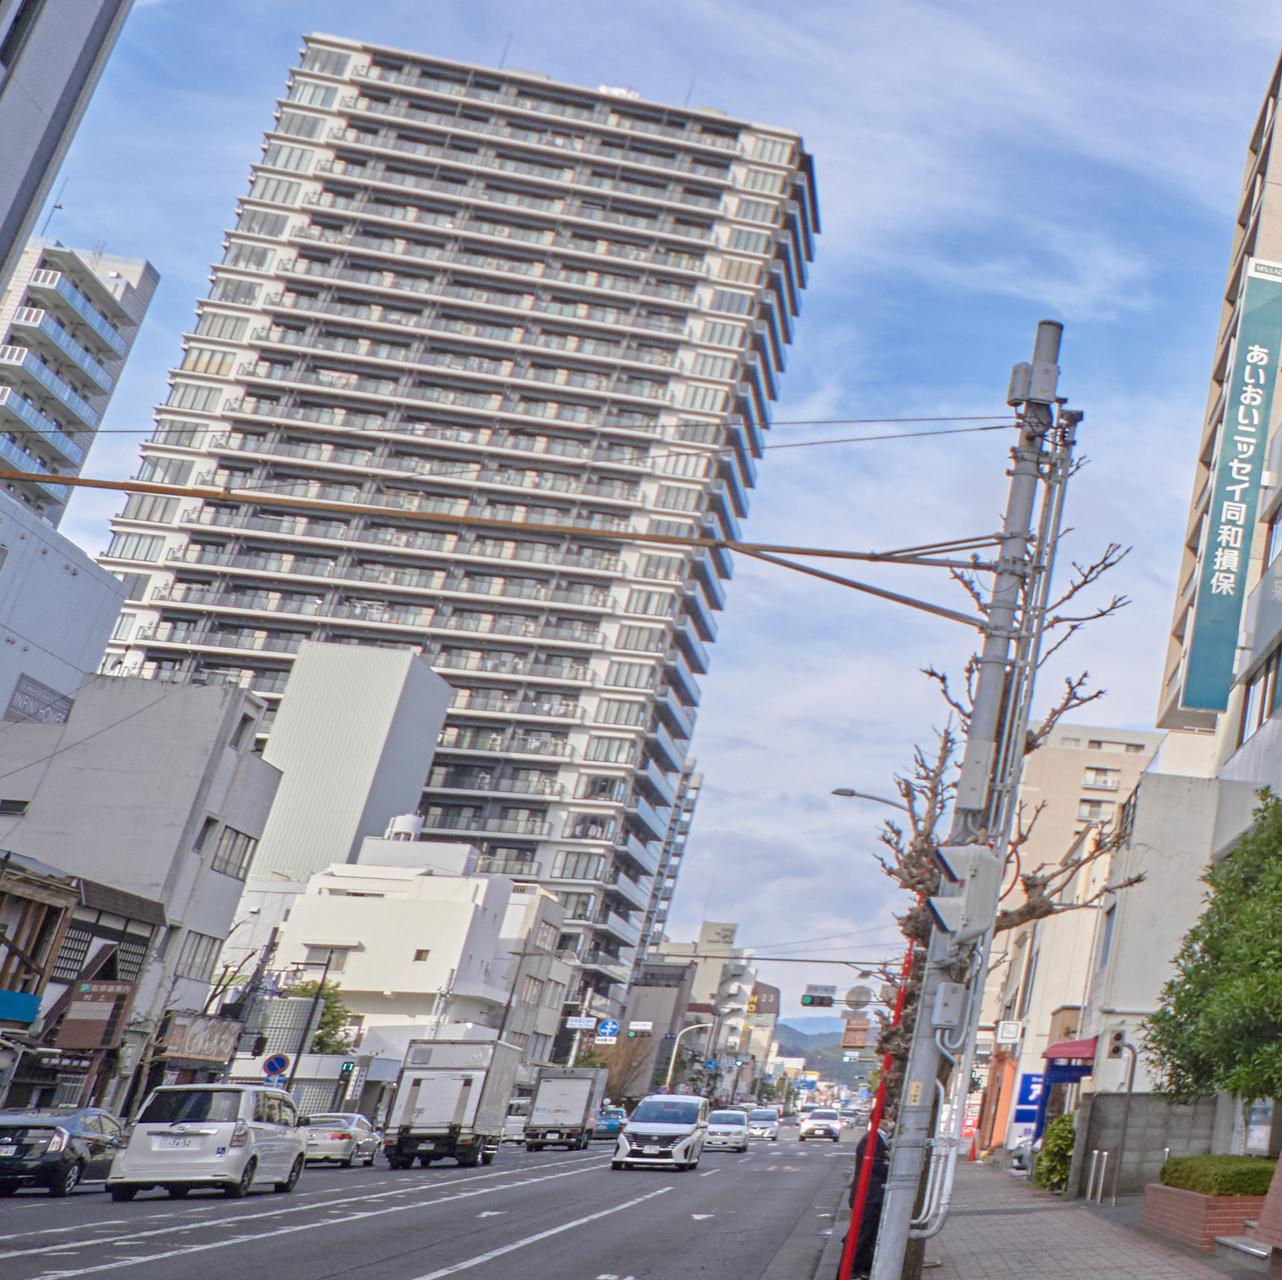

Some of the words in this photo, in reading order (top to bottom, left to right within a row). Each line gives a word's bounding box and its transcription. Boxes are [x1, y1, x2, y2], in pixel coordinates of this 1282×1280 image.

[1210, 344, 1269, 596] あいおいニッセイ同和損保
